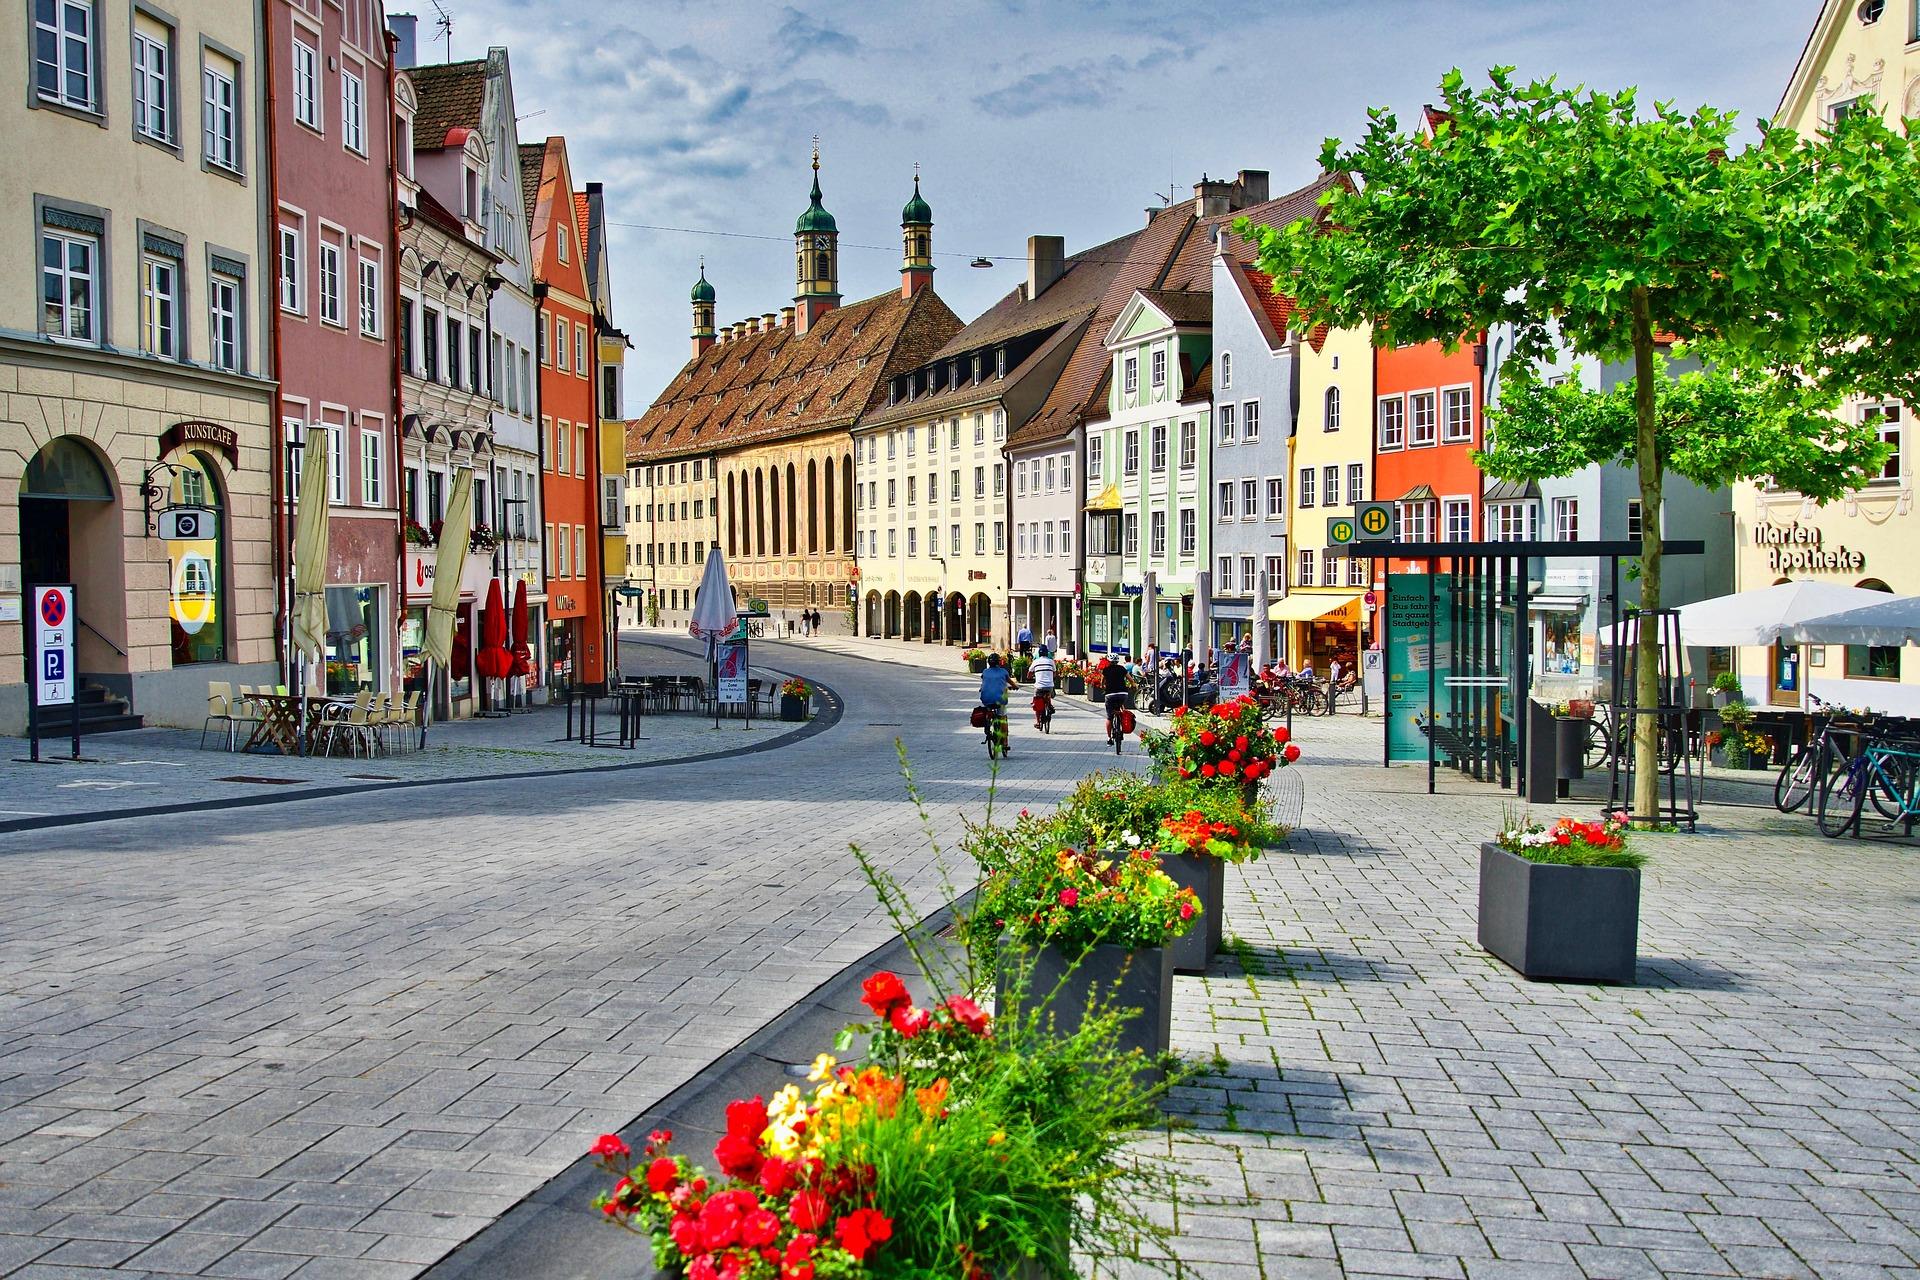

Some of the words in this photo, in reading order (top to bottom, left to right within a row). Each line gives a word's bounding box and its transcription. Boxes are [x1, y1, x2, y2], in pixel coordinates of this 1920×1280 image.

[184, 424, 232, 446] KUNSTCAFE
[1369, 512, 1381, 529] H
[1337, 525, 1347, 538] H
[1753, 521, 1821, 545] Marien
[1768, 545, 1864, 576] Apotheke
[1392, 594, 1425, 602] Einfach
[1410, 602, 1439, 610] fahrn
[1392, 611, 1403, 619] im
[1405, 612, 1431, 621] ganze
[1392, 620, 1443, 629] Stadtgebet.
[47, 653, 59, 677] P
